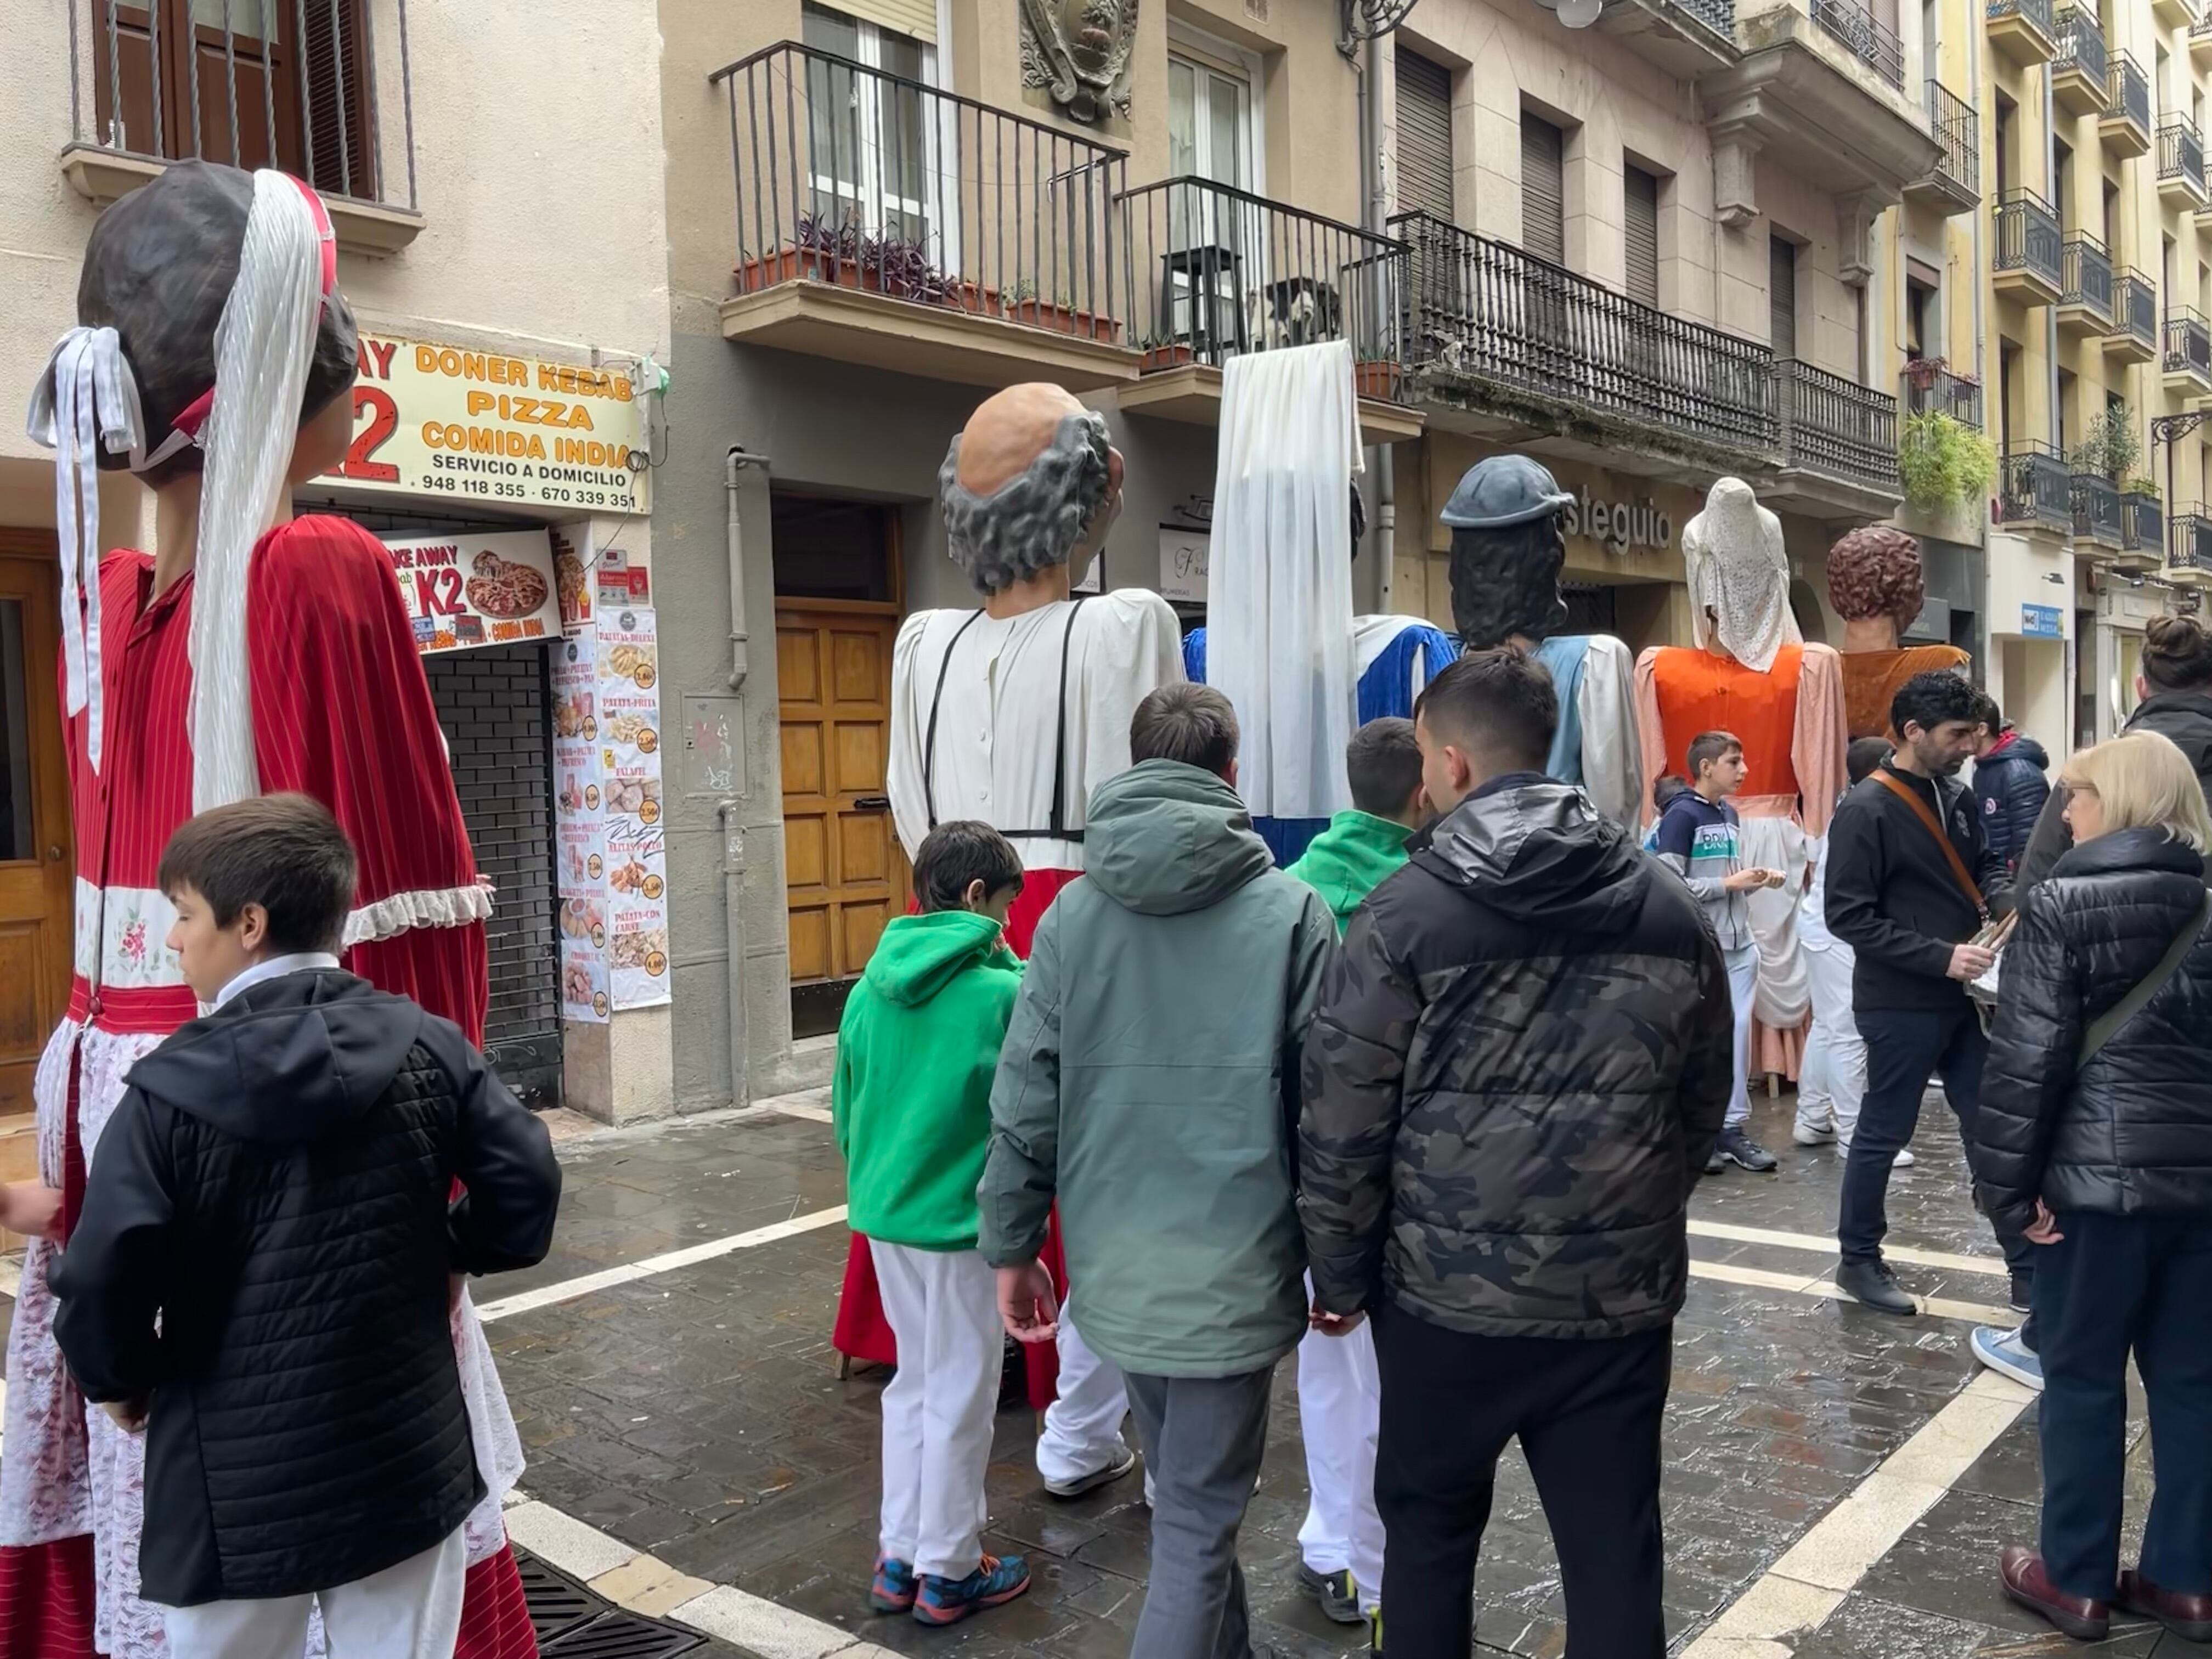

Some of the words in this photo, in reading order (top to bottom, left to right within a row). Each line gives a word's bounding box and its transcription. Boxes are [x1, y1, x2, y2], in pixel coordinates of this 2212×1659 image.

[415, 346, 528, 387] DONER
[538, 364, 633, 402] KEBAB
[467, 390, 594, 431] PIZZA
[325, 385, 400, 483] 2
[422, 421, 547, 460] COMIDA
[555, 437, 630, 470] INDIA
[422, 475, 455, 490] 948
[462, 479, 488, 493] 118
[495, 482, 525, 498] 355
[541, 487, 571, 501] 670
[575, 490, 604, 505] 339
[610, 494, 636, 507] 351
[432, 454, 517, 476] SERVICIO
[523, 465, 533, 477] A
[539, 466, 626, 487] DOMICILIO
[416, 545, 459, 567] AWAY
[415, 567, 467, 616] K2
